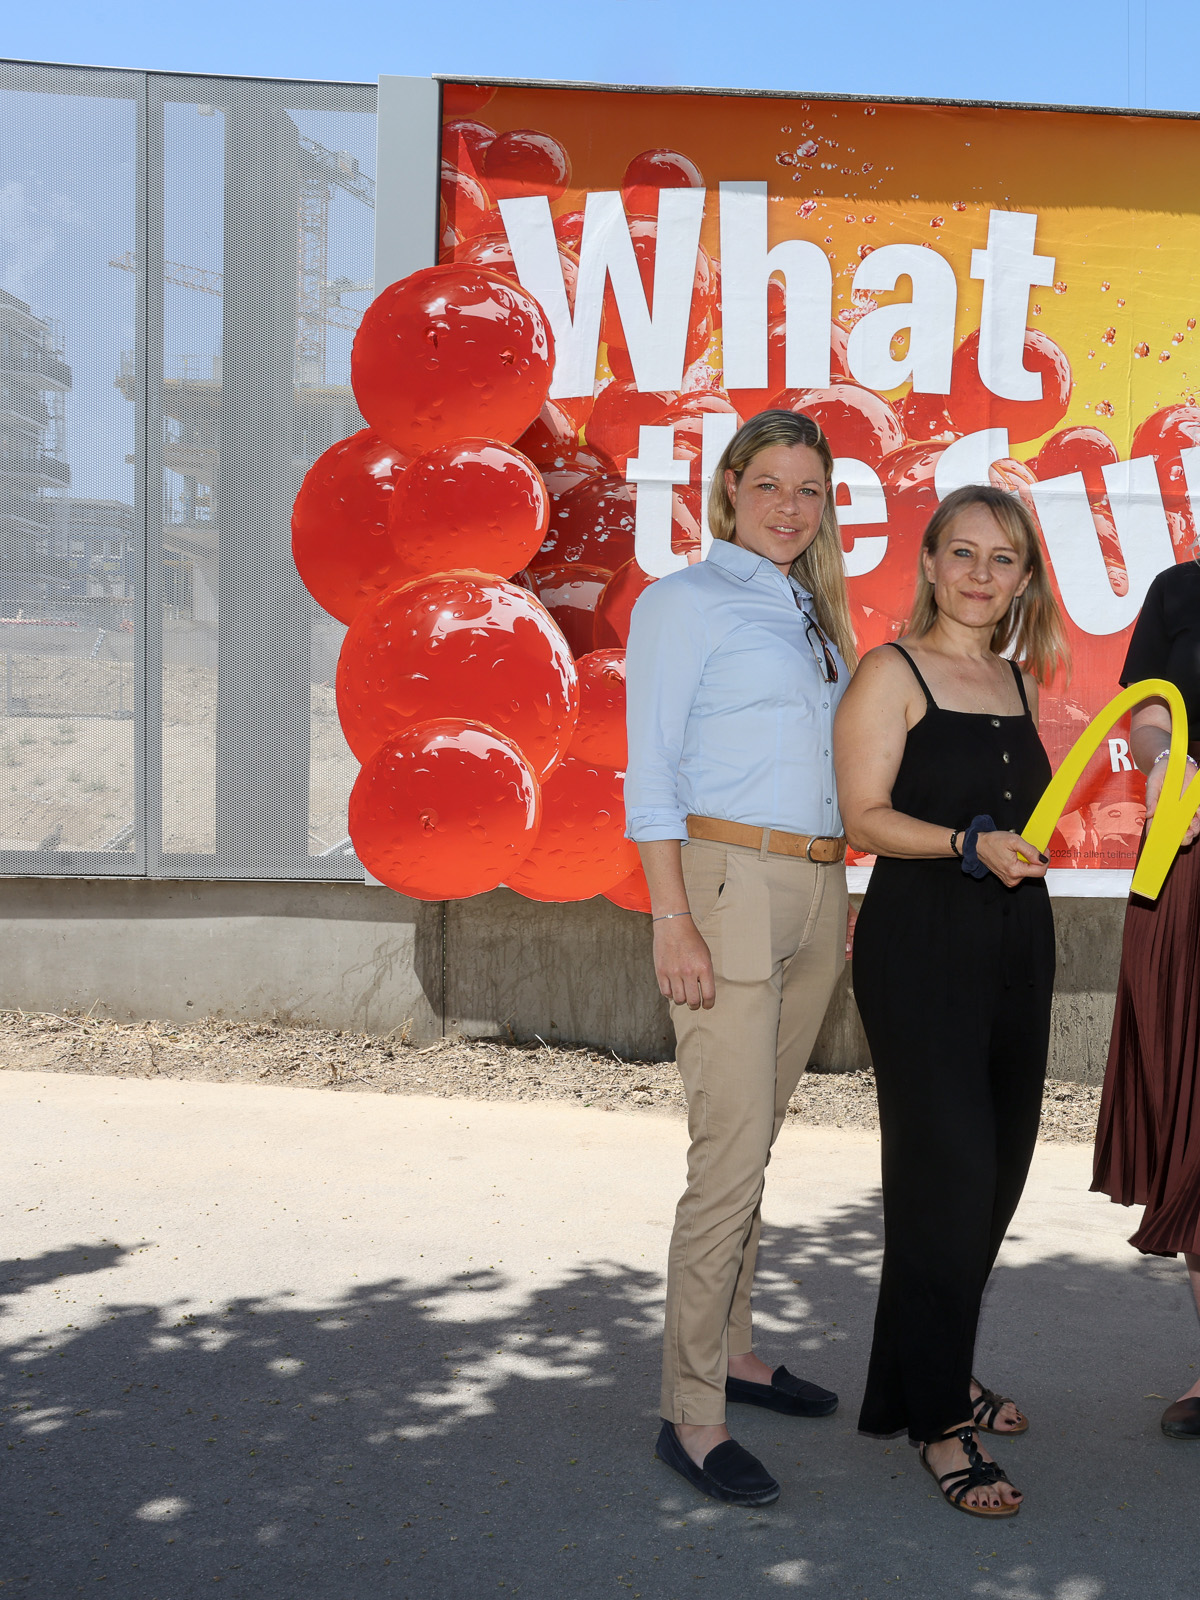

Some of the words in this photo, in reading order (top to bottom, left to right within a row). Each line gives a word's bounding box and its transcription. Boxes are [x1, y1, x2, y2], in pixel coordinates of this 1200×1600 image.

[498, 180, 1056, 401] What
[625, 412, 889, 579] te
[1050, 849, 1072, 858] 2025
[1073, 849, 1082, 858] in
[1083, 849, 1105, 858] allen
